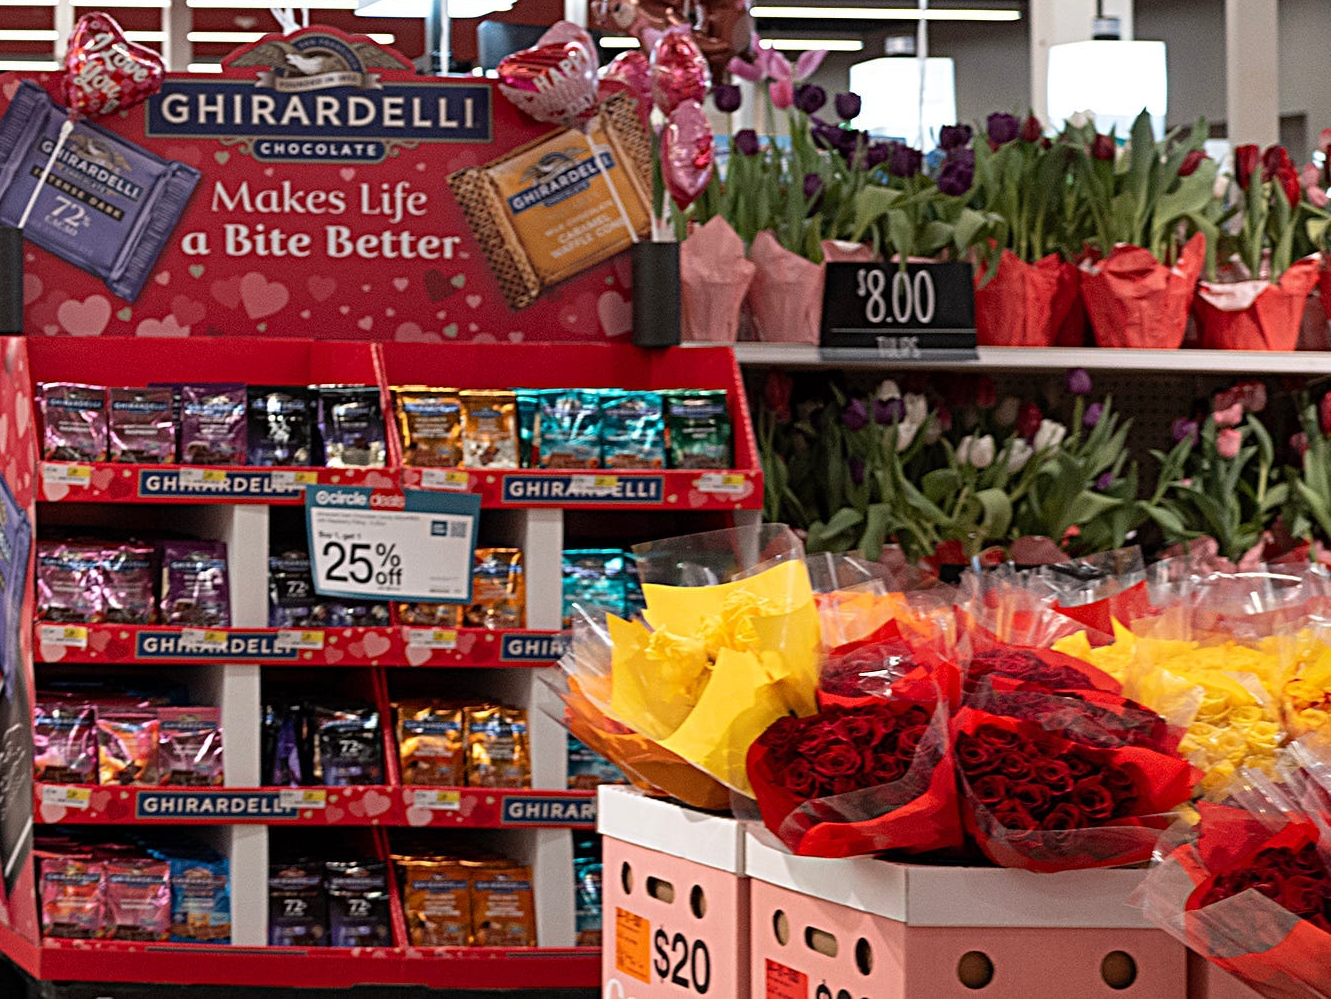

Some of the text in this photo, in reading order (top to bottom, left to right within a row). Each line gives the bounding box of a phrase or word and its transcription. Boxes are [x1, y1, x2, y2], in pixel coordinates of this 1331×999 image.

[161, 93, 473, 129] GHIRARDELLI
[260, 142, 377, 157] CHOCOLATE
[512, 155, 610, 210] GHIRARDELI
[212, 180, 428, 223] Makes Life
[181, 232, 210, 255] a
[225, 223, 311, 257] Bite
[857, 268, 936, 324] $8.00
[509, 481, 657, 497] GHIRELLI
[375, 568, 404, 586] off
[654, 924, 711, 995] $20
